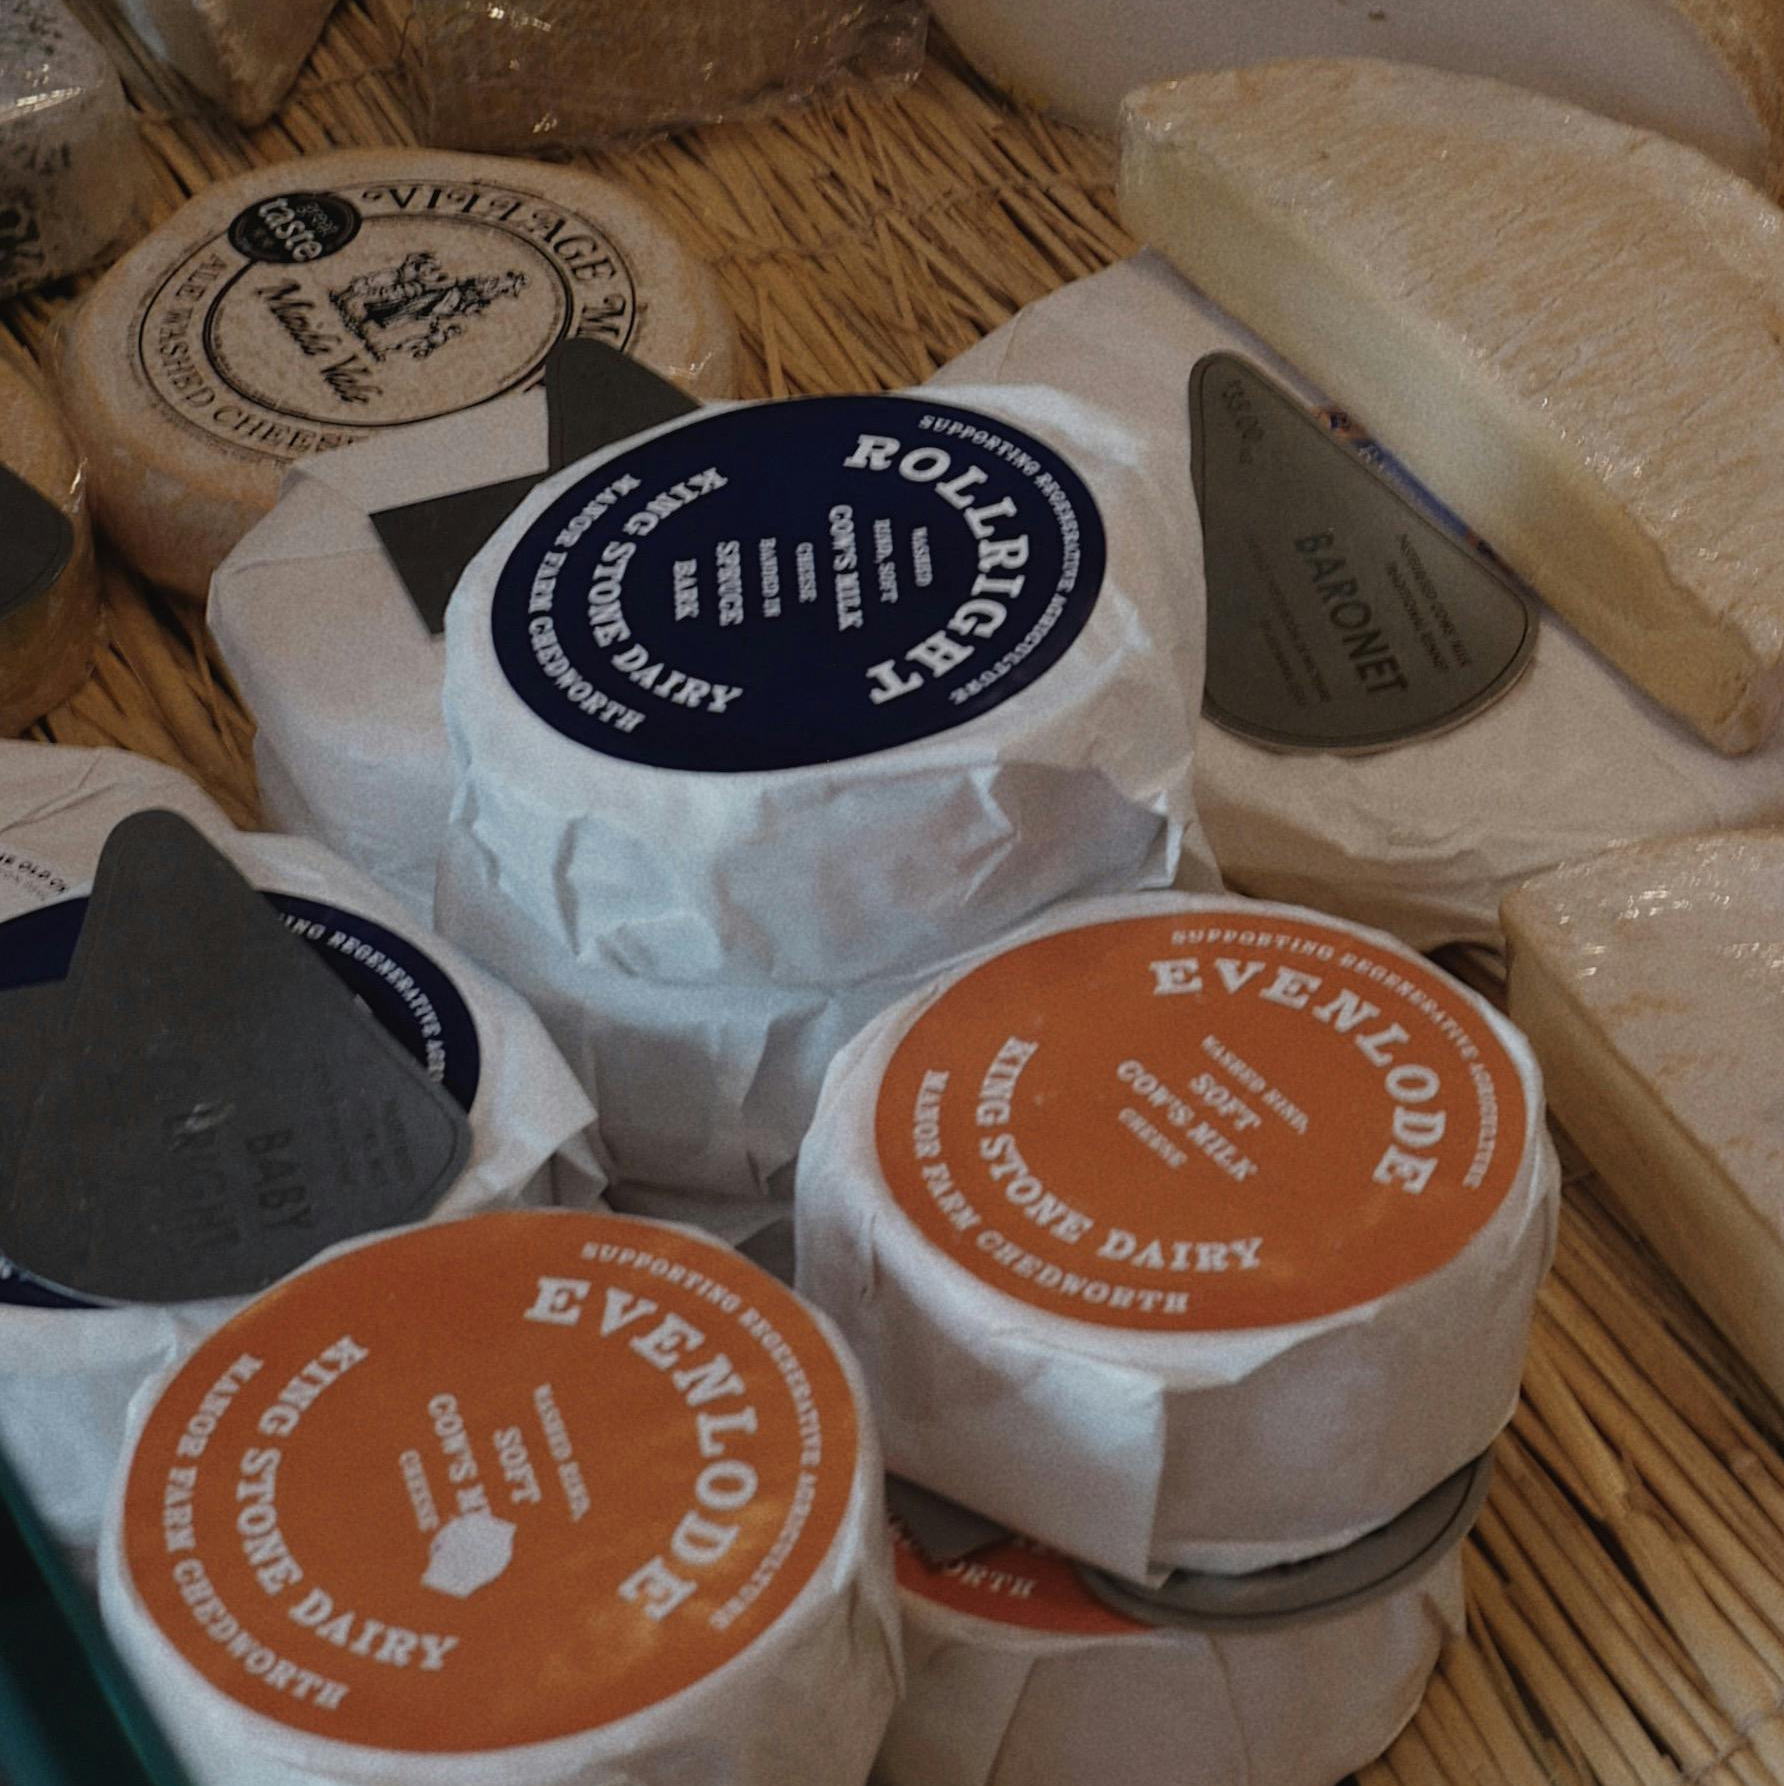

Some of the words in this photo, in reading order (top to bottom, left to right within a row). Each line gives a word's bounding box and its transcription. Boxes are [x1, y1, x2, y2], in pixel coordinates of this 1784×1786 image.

[387, 186, 615, 284] VILLAGE
[212, 405, 369, 454] CHEES
[918, 415, 1041, 476] SUPPORTING
[554, 473, 642, 548] MANOR
[622, 466, 729, 536] KING
[528, 551, 568, 615] FARM
[586, 540, 637, 649] STONE
[674, 558, 700, 622] BARK
[716, 540, 744, 628] SPRUCE
[835, 572, 865, 632] MILK
[844, 434, 1029, 705] ROLLRIGHT
[1294, 530, 1409, 695] BARONET
[528, 616, 647, 734] CHEDWORTH
[610, 643, 744, 713] DAIRY
[1170, 928, 1336, 962] SUPPORTING
[1338, 952, 1480, 1061] REGENERATIVE
[913, 1069, 950, 1160] MANOR
[975, 1035, 1040, 1128] KING
[1115, 1058, 1196, 1127] COW'S
[1185, 1120, 1259, 1183] MILK
[1148, 957, 1446, 1195] EVENLODE
[1188, 1071, 1263, 1132] SOFT
[921, 1162, 982, 1231] FARM
[979, 1132, 1095, 1245] STONE
[581, 1241, 742, 1314] SUPPORTING
[975, 1229, 1190, 1315] CHEDWORTH
[1097, 1228, 1264, 1272] DAIRY
[176, 1351, 265, 1459] MANOR
[258, 1333, 371, 1437] KING
[427, 1392, 479, 1486] COW'S
[493, 1425, 542, 1506] SOFT
[524, 1275, 759, 1623] EVENLODE
[163, 1464, 197, 1553] FARM
[236, 1447, 303, 1597] STONE
[172, 1558, 351, 1712] CHEDWORTH
[289, 1586, 460, 1672] DAIRY
